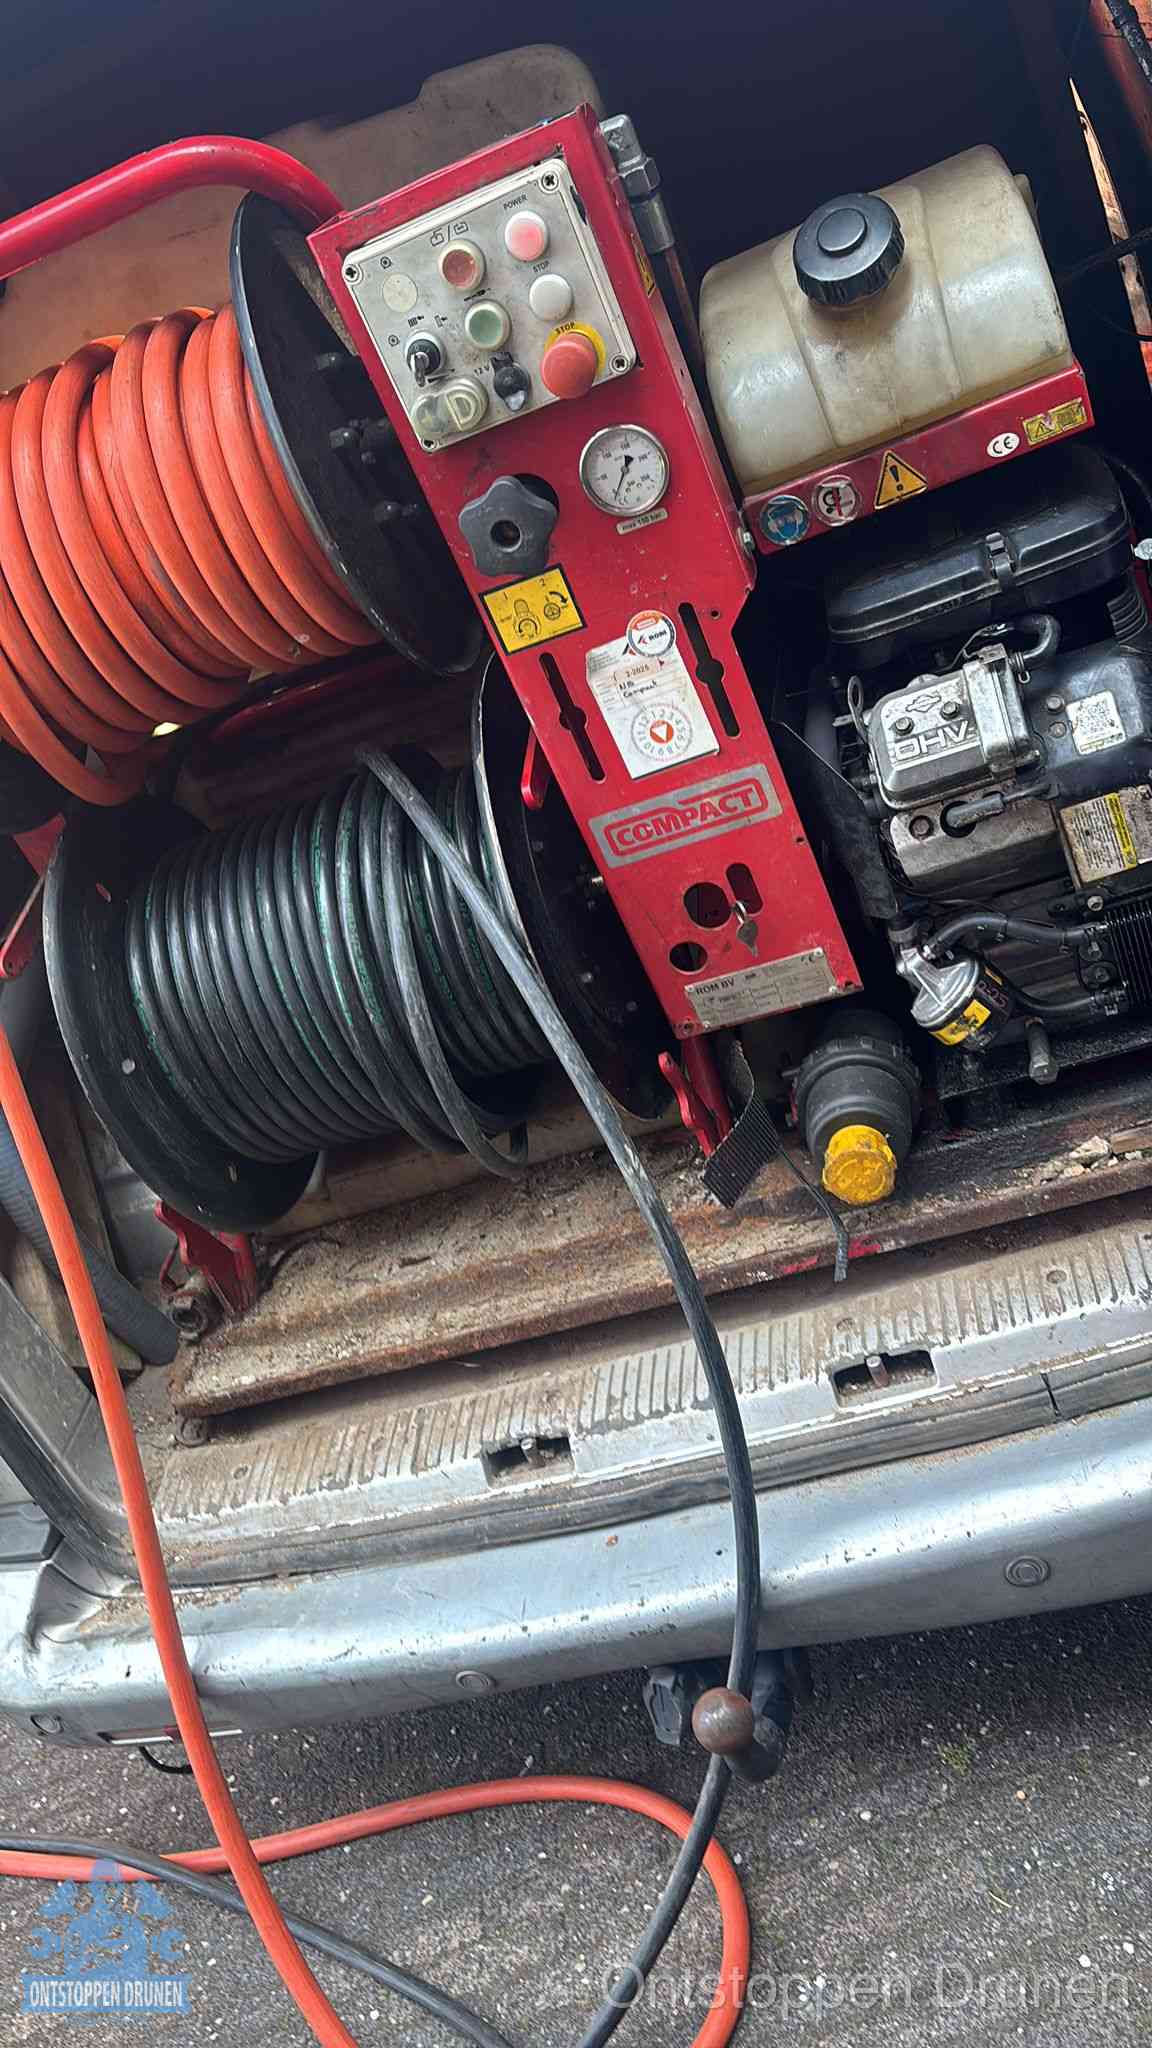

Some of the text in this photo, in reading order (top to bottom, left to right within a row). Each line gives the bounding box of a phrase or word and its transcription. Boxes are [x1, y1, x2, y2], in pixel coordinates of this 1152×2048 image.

[503, 194, 528, 210] POWER
[532, 260, 550, 273] STOP
[555, 321, 576, 335] STOP
[992, 435, 1013, 455] CE
[616, 788, 754, 846] COMPACT
[696, 983, 720, 995] ROM
[721, 976, 735, 989] BV
